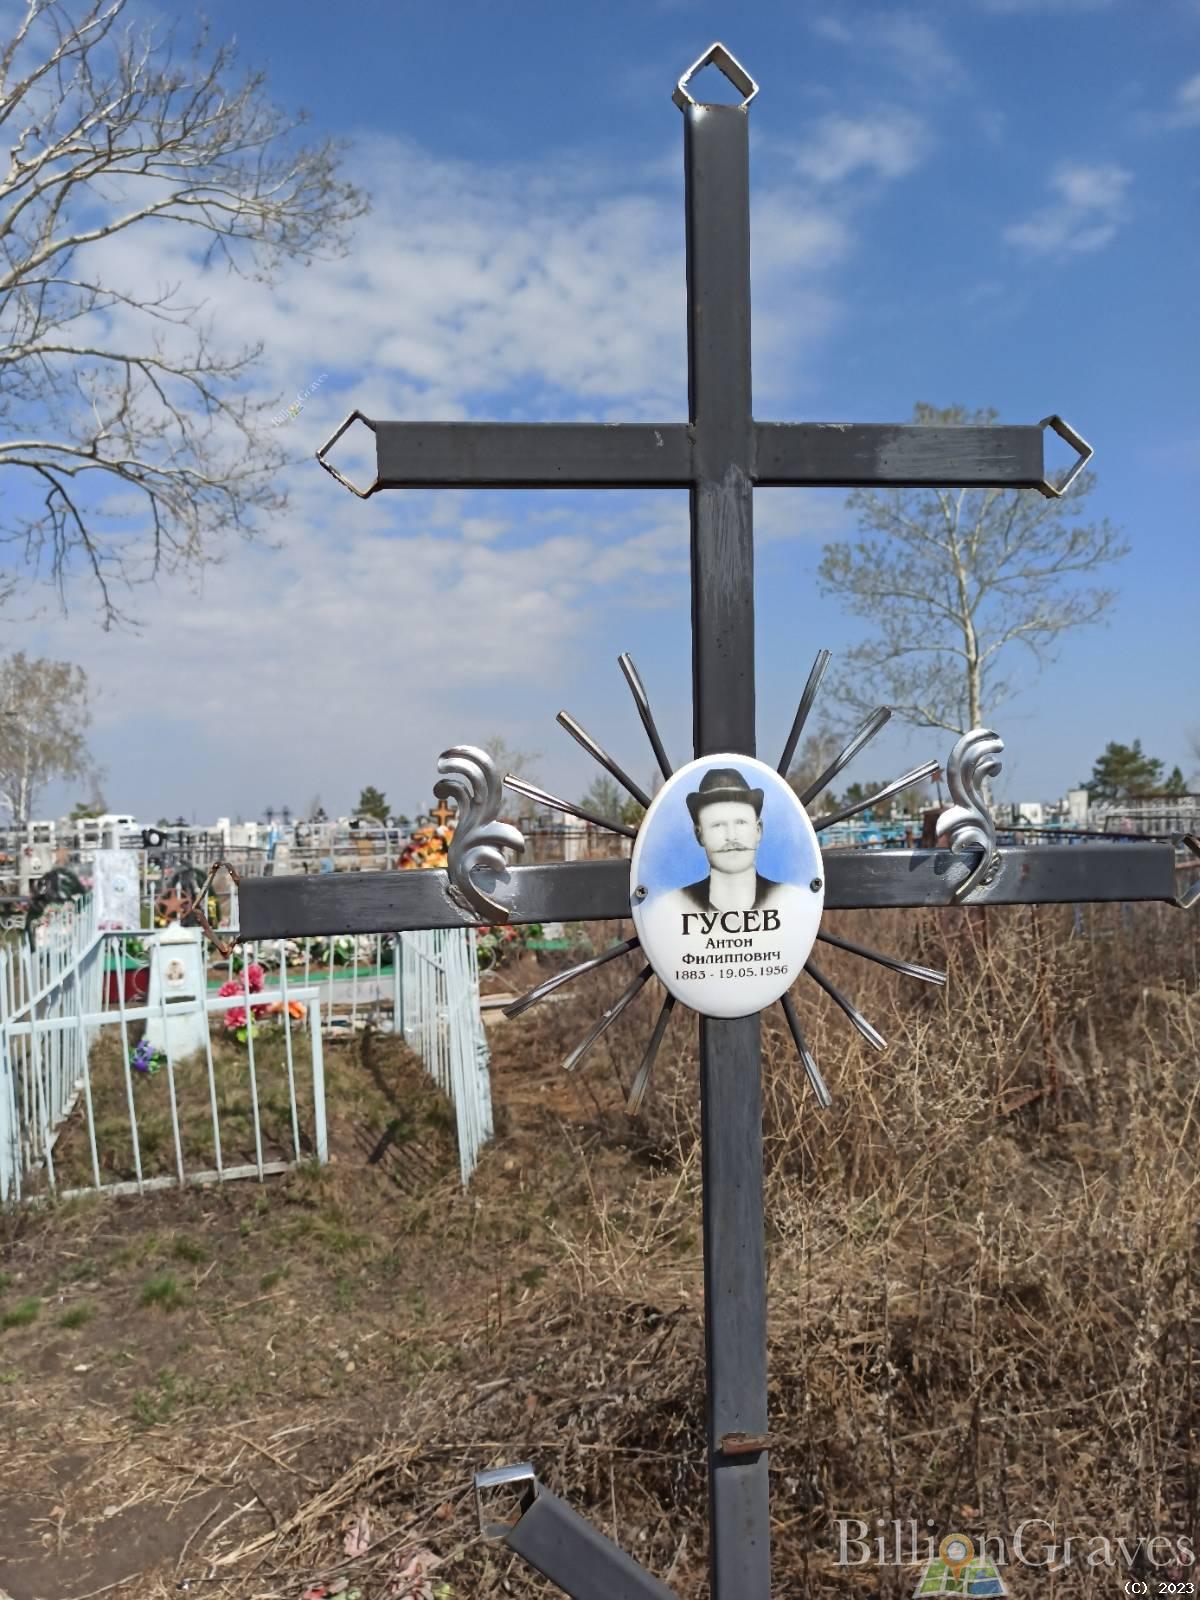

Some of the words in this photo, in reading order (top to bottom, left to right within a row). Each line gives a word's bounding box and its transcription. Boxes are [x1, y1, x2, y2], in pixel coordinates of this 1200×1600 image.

[681, 909, 781, 935] ГУСЕВ
[681, 951, 781, 965] Филиппович
[719, 965, 788, 979] 19.05.1956
